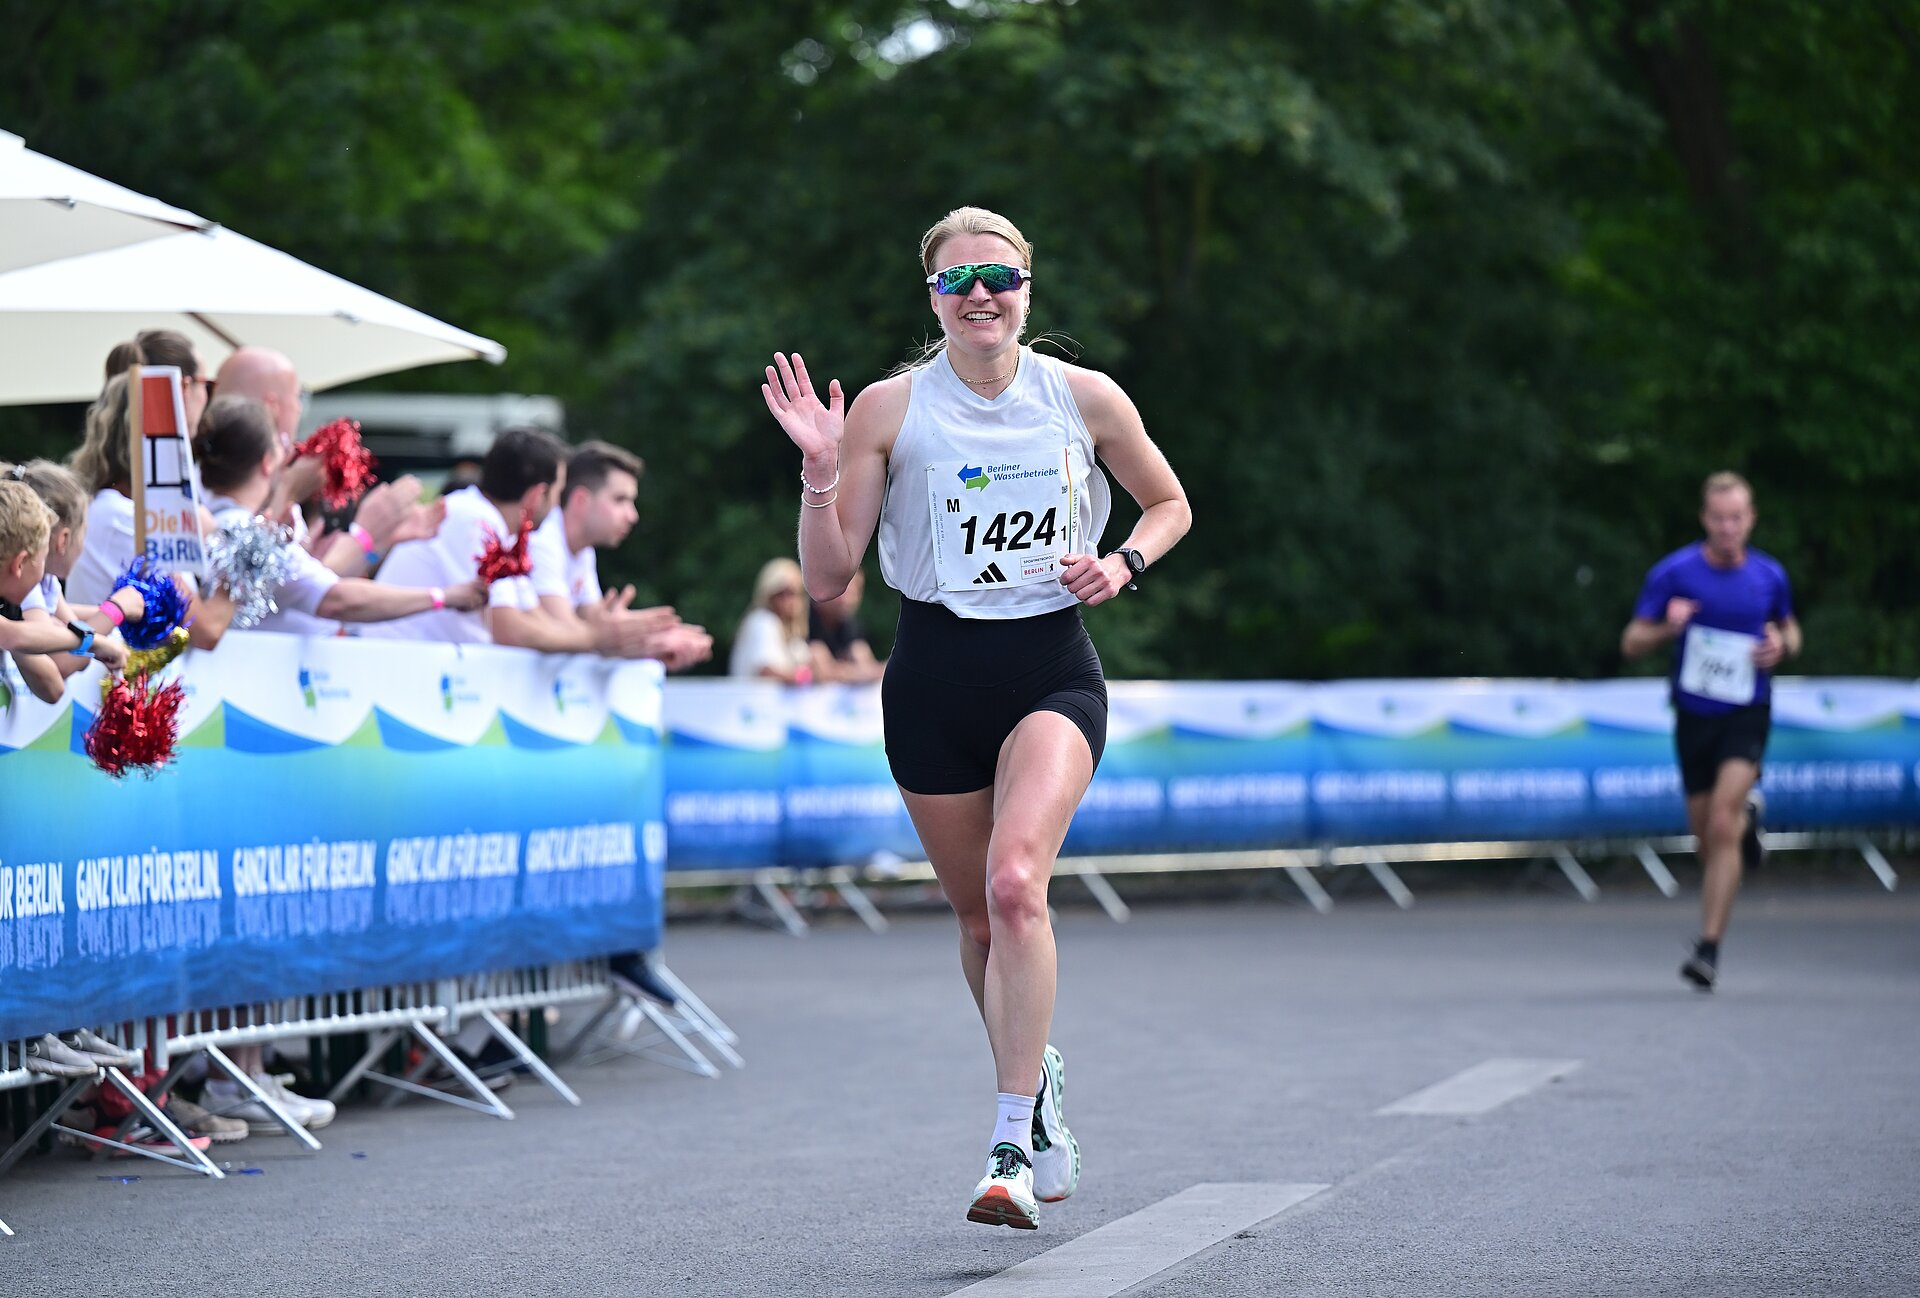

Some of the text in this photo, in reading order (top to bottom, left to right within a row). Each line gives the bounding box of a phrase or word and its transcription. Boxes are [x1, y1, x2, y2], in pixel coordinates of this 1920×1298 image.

[987, 463, 1021, 474] Berliner
[993, 467, 1059, 481] Wasserbetriebe
[946, 499, 960, 513] M
[145, 507, 177, 535] Die
[960, 507, 1057, 555] 1424
[1060, 525, 1067, 541] 1
[1023, 567, 1044, 576] BERLIN
[76, 857, 110, 912] GANZ
[111, 854, 141, 907] KLAR
[141, 845, 174, 903] FÜR
[232, 846, 268, 897] GANZ
